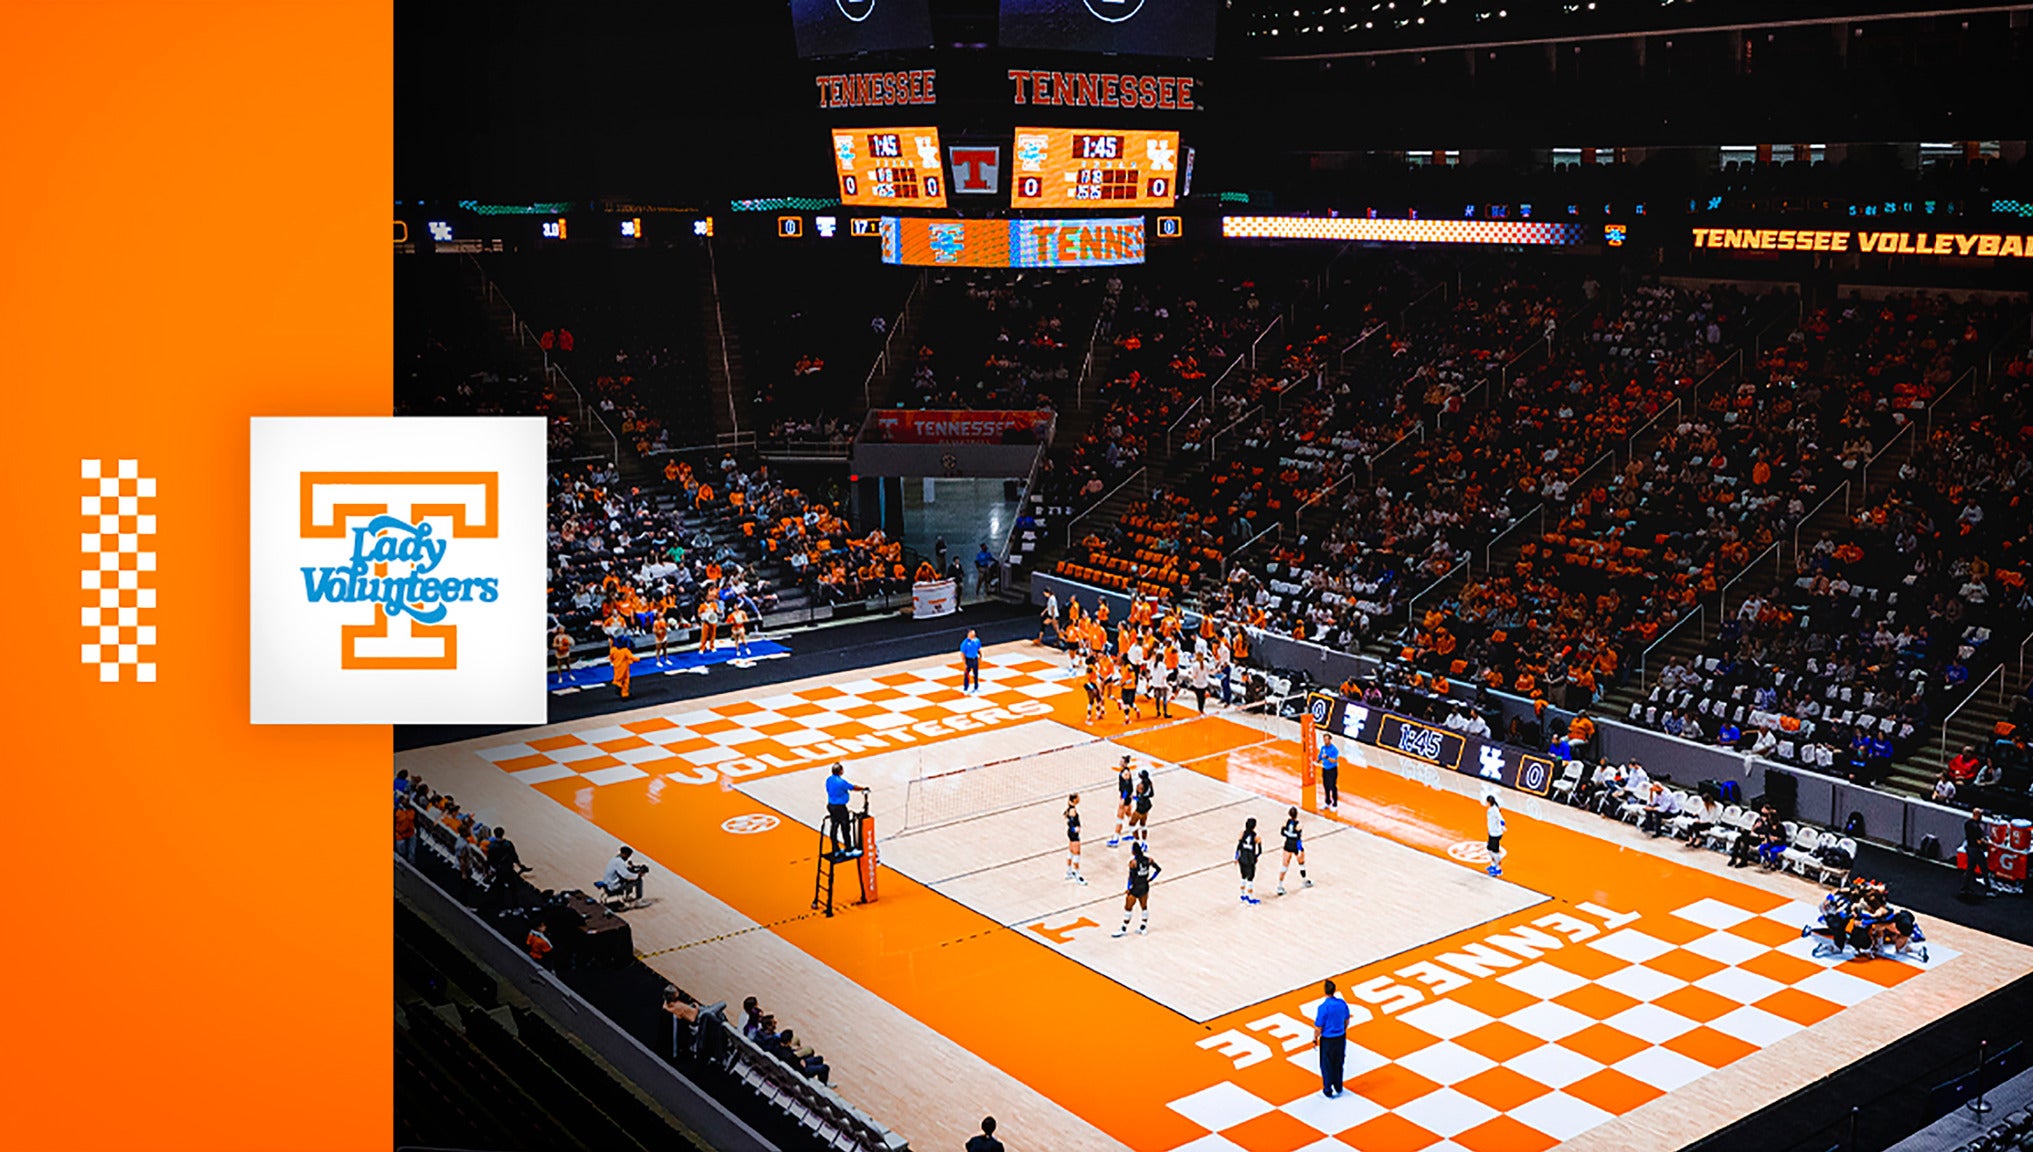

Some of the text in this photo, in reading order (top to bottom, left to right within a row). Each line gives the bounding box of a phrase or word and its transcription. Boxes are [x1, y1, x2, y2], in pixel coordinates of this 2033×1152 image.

[816, 69, 937, 107] TENNESSEE
[1008, 70, 1194, 109] TENNESSEE
[873, 135, 899, 156] 1:45
[1082, 136, 1117, 158] 1:45
[953, 149, 997, 189] T
[846, 177, 855, 194] 0
[927, 178, 937, 196] 0
[1024, 178, 1038, 196] 0
[1152, 179, 1166, 196] 0
[785, 219, 796, 235] 0
[1164, 219, 1175, 235] 0
[1693, 229, 1850, 251] TENNESSEE
[1312, 699, 1326, 722] 0
[1399, 723, 1443, 760] 1:45
[1526, 762, 1544, 789] 0
